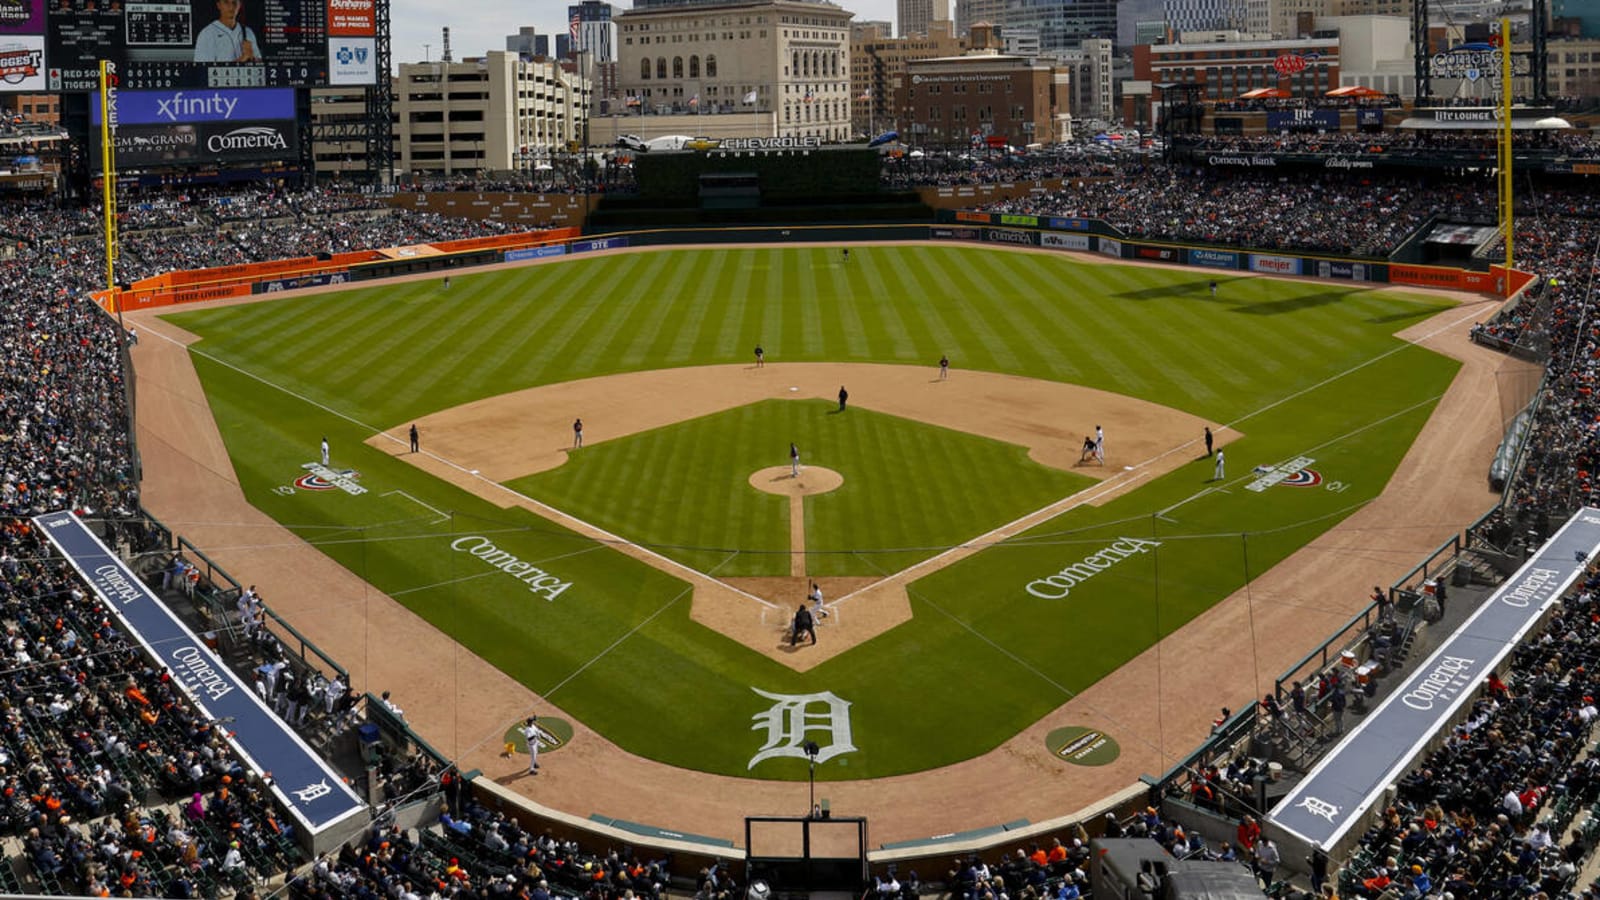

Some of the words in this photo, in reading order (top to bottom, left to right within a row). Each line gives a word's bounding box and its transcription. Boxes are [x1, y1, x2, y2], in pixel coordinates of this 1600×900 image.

[270, 68, 277, 78] 2
[286, 68, 291, 78] 1
[301, 68, 308, 78] 0
[157, 92, 238, 120] xfinity
[1454, 112, 1490, 120] LOUNGE
[151, 132, 194, 145] GRAND
[207, 132, 288, 152] Comerica
[724, 136, 822, 149] CHEVROLET
[118, 144, 177, 153] DETROIT
[706, 150, 809, 158] FOUNTAIN
[1208, 156, 1250, 166] Comerica
[1252, 157, 1277, 165] Bank
[989, 230, 1032, 244] Comerica
[591, 241, 609, 250] DTE
[1258, 257, 1291, 272] meijer
[451, 535, 573, 601] Comerica
[1025, 536, 1162, 600] Comerica
[94, 563, 143, 604] Comerica
[1501, 567, 1560, 608] Comerica
[172, 646, 235, 700] Comerica
[1402, 655, 1475, 710] Comerica
[1439, 673, 1471, 701] PARK
